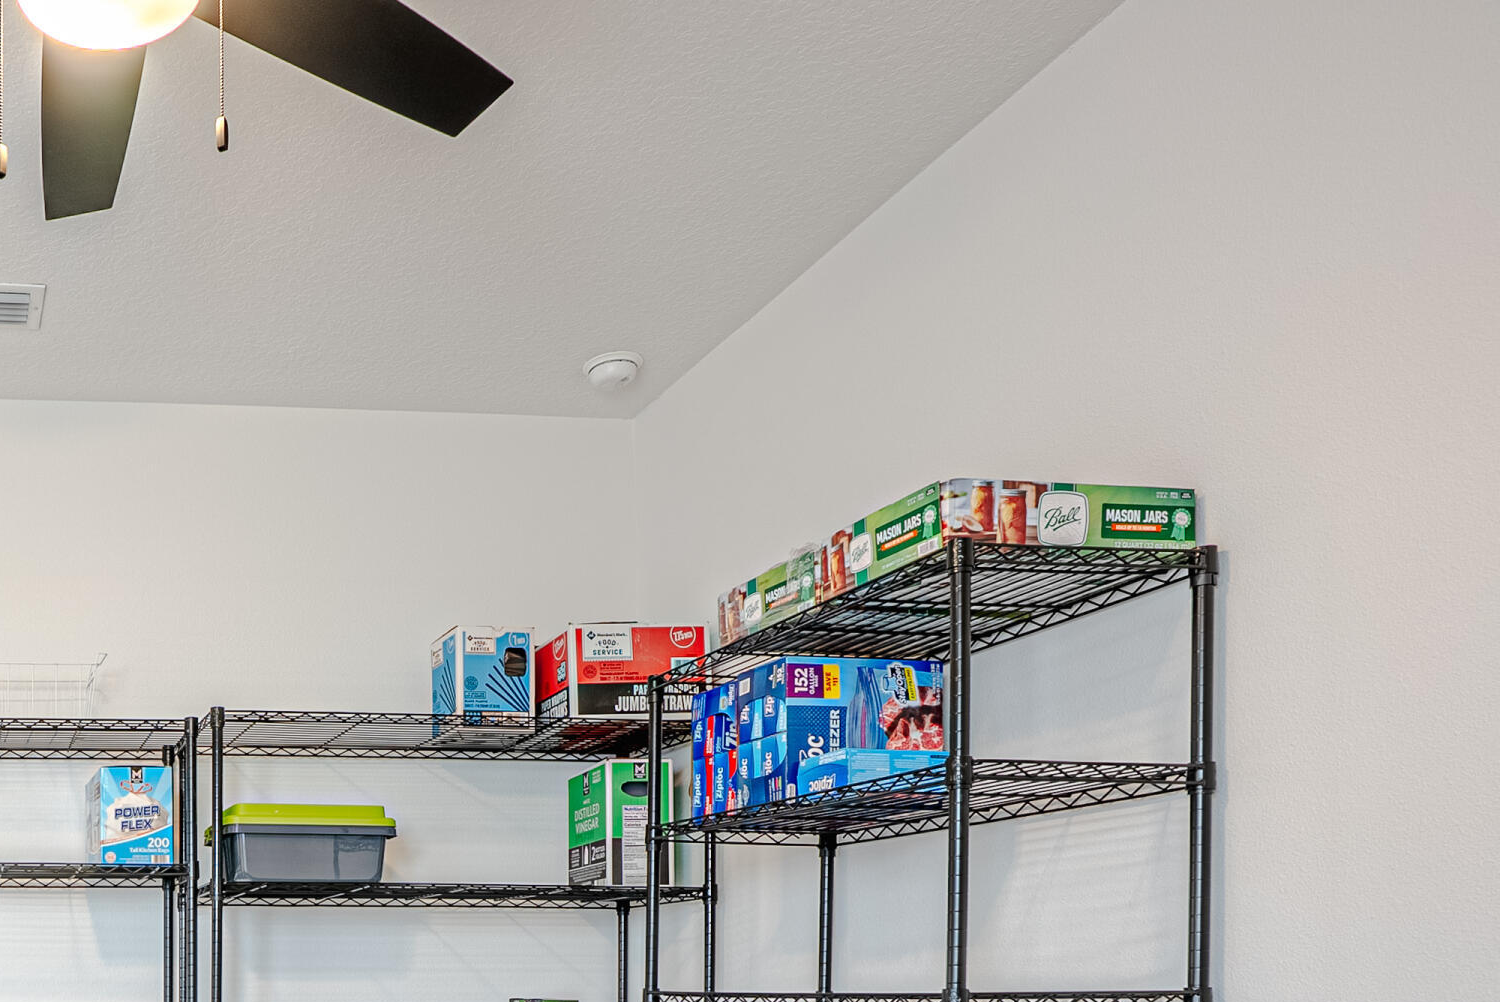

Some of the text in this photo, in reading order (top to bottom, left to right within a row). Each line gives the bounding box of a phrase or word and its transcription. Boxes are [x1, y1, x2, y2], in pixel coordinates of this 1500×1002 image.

[1044, 506, 1082, 532] Ball
[1105, 508, 1168, 524] MASON JARS
[876, 523, 902, 545] MASON
[903, 513, 921, 533] JARS
[794, 668, 808, 693] 152
[615, 695, 693, 712] JUMB TRAW
[765, 696, 775, 715] Zip
[830, 709, 840, 752] EEZER
[694, 774, 702, 805] Ziploc
[716, 767, 724, 800] Ziploc
[115, 805, 160, 819] POWER
[574, 803, 600, 822] DISTILLED
[121, 819, 153, 831] FLEX
[575, 817, 599, 834] VINEGAR
[148, 837, 170, 848] 200
